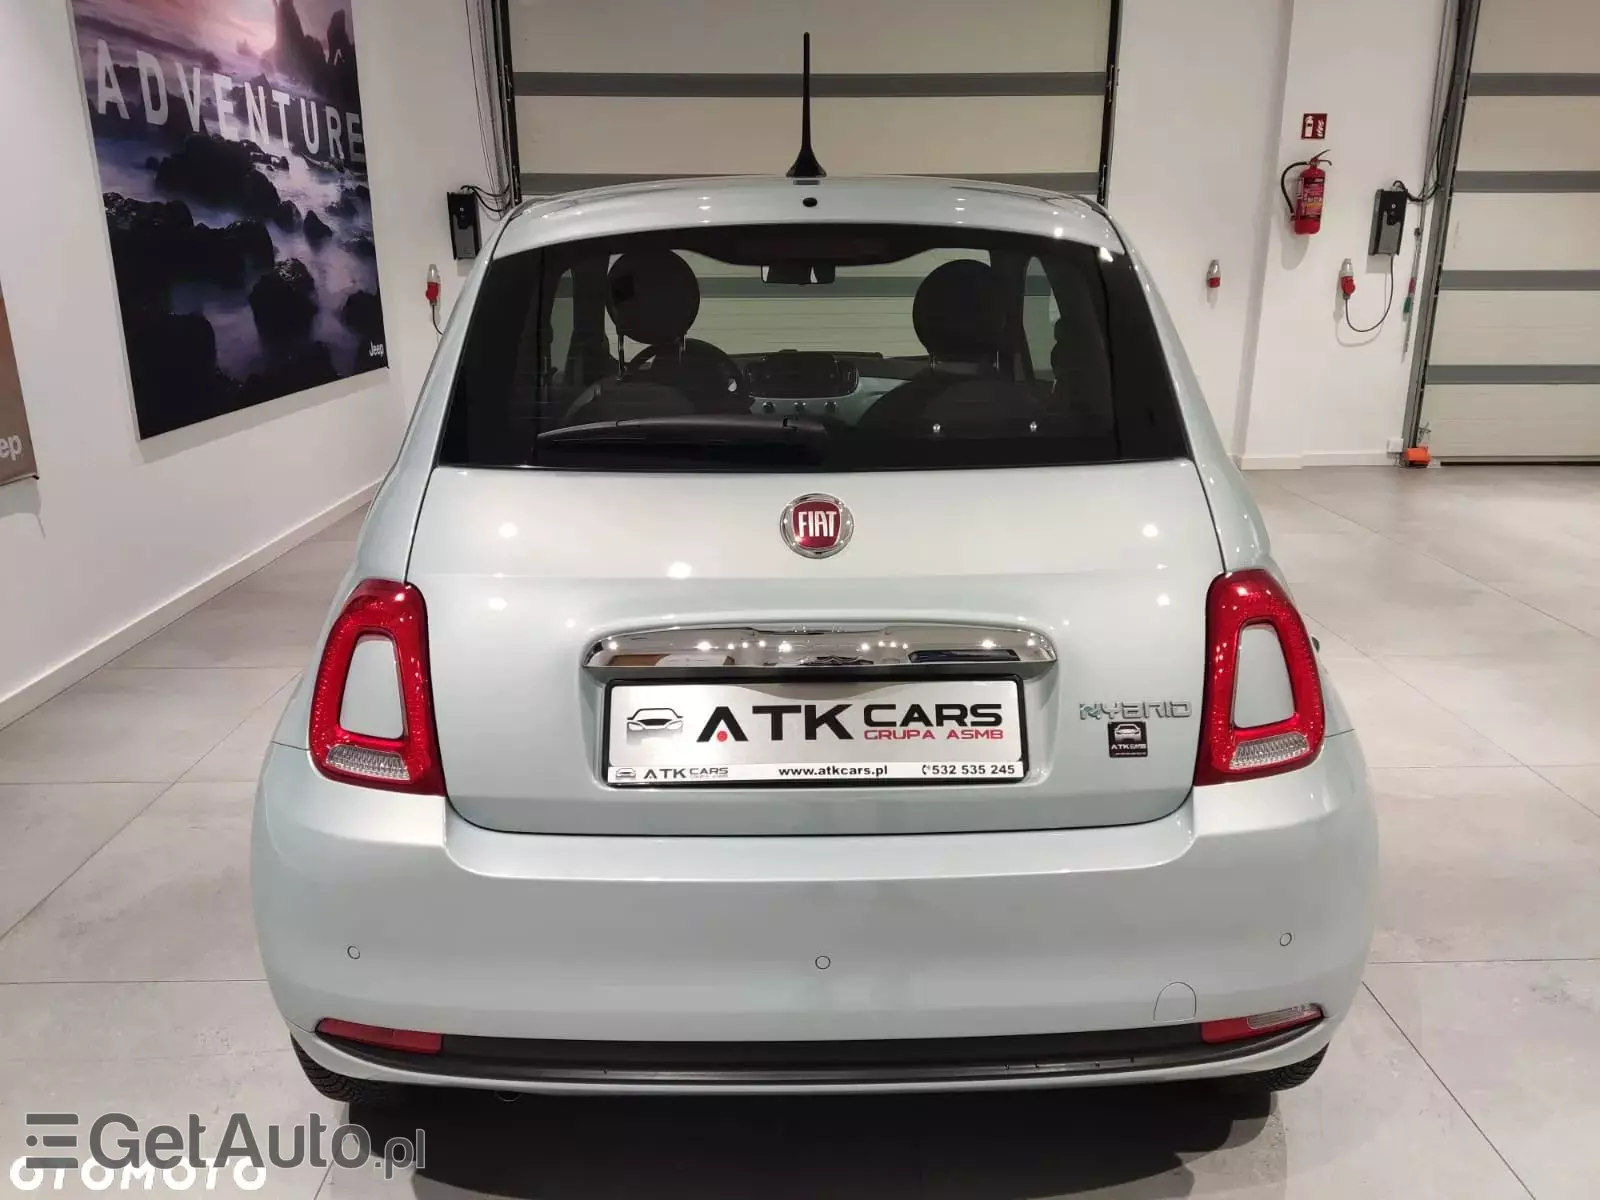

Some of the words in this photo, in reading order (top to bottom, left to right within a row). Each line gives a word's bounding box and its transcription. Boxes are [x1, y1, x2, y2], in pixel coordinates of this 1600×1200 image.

[97, 38, 364, 163] ADVENTURE
[369, 340, 384, 357] Jeep
[798, 510, 837, 538] FIAT
[1080, 700, 1192, 720] HYBRID
[697, 704, 854, 743] ATK
[864, 704, 1001, 727] CARS
[864, 728, 936, 740] GRUPA
[946, 728, 1004, 740] ASMB
[643, 768, 687, 780] ATK
[689, 766, 729, 775] CARS
[778, 765, 888, 777] www.atkcars.pl
[932, 764, 957, 775] 532
[961, 764, 986, 775] 535
[990, 763, 1015, 775] 245
